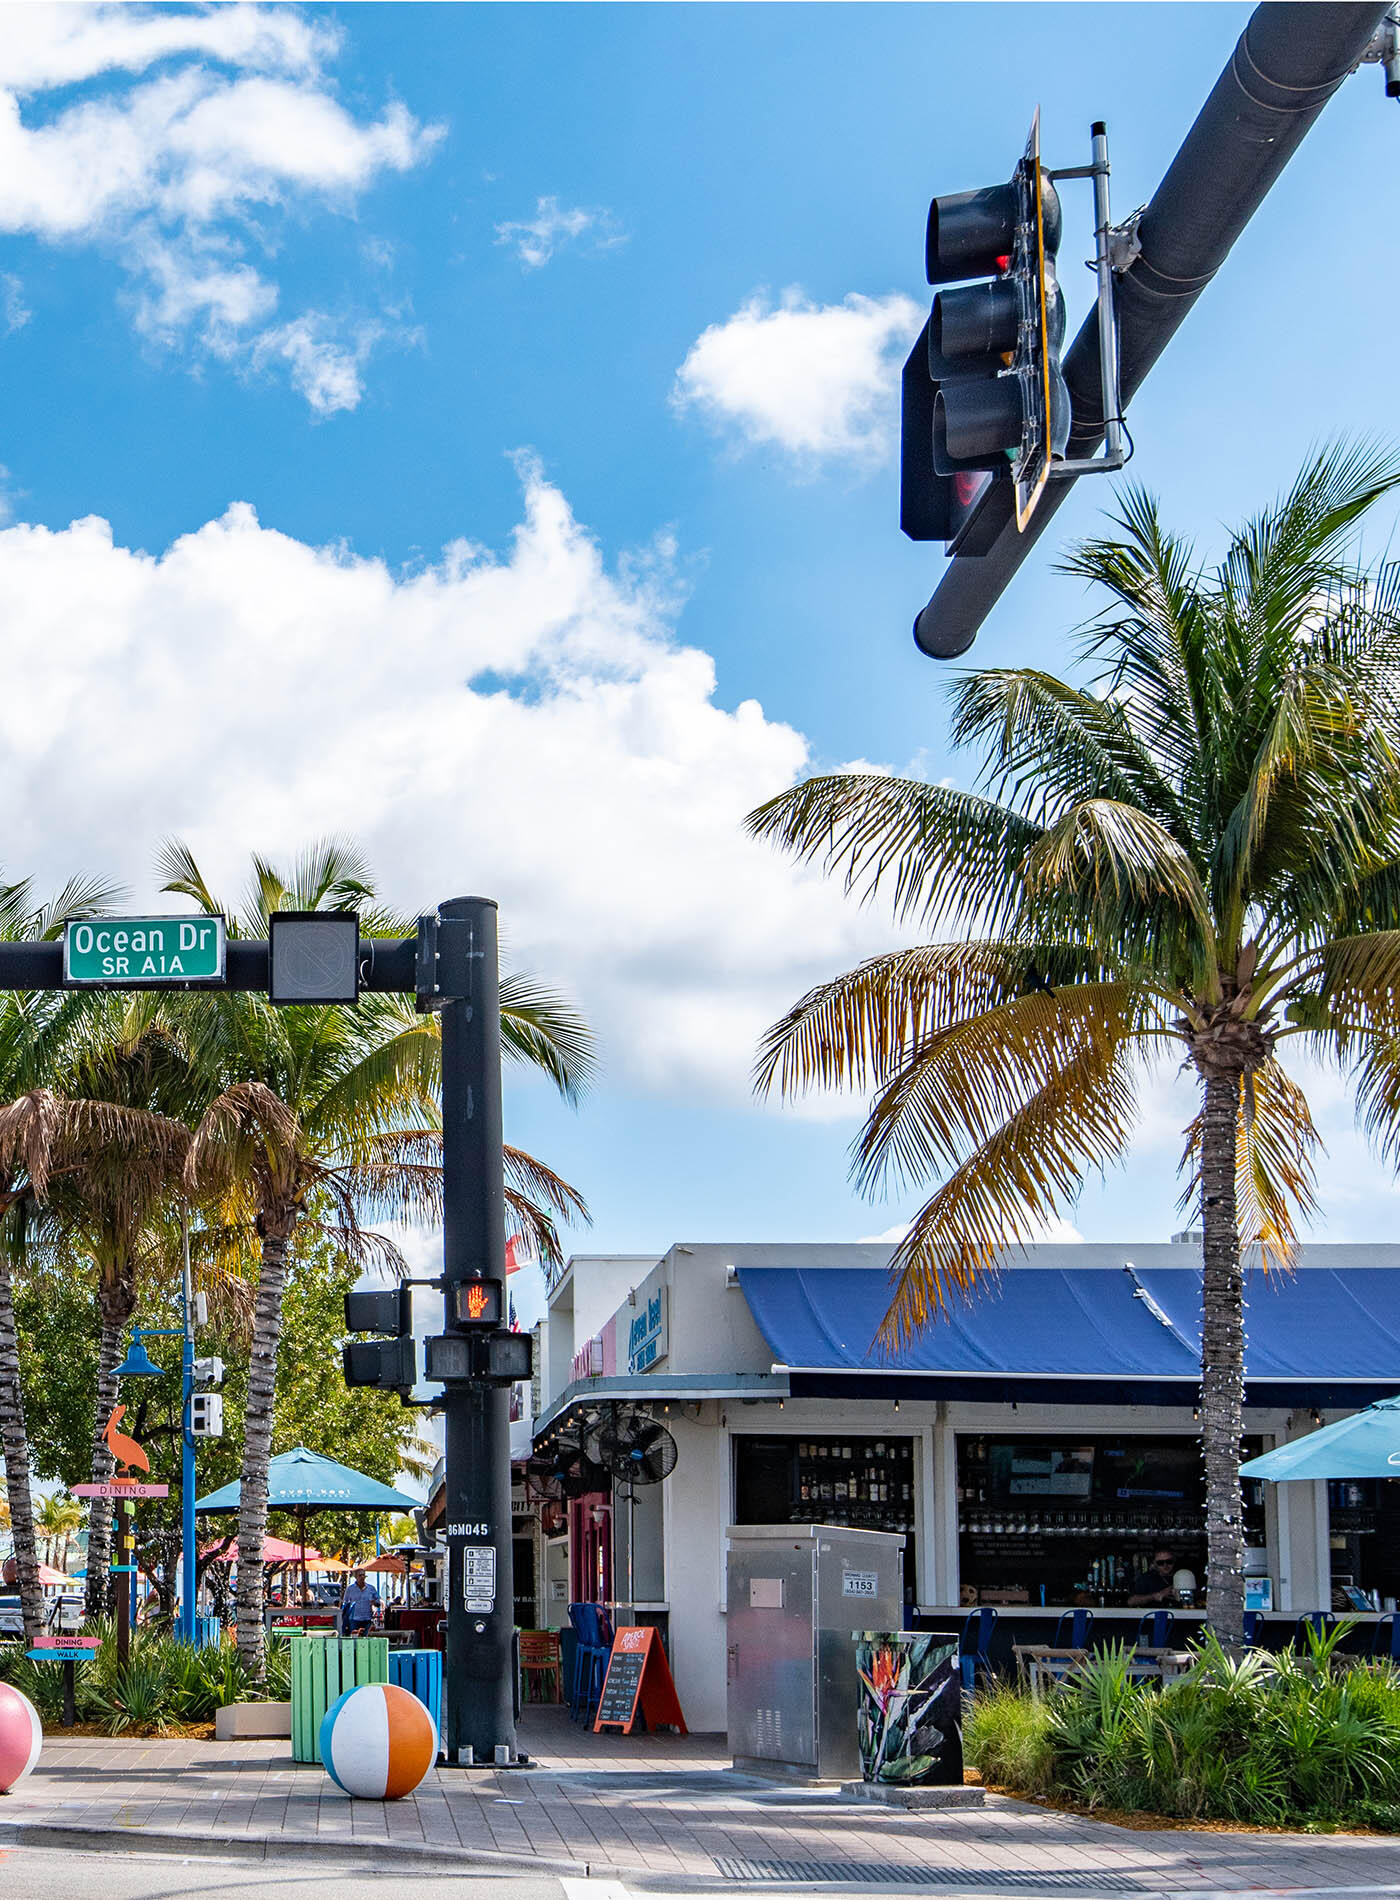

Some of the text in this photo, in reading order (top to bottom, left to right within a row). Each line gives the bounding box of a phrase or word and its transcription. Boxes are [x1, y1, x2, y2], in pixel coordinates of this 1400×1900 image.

[75, 923, 211, 954] Ocean Dr
[102, 956, 184, 975] SR A1A
[100, 1486, 146, 1494] DINING
[849, 1581, 873, 1590] 1153
